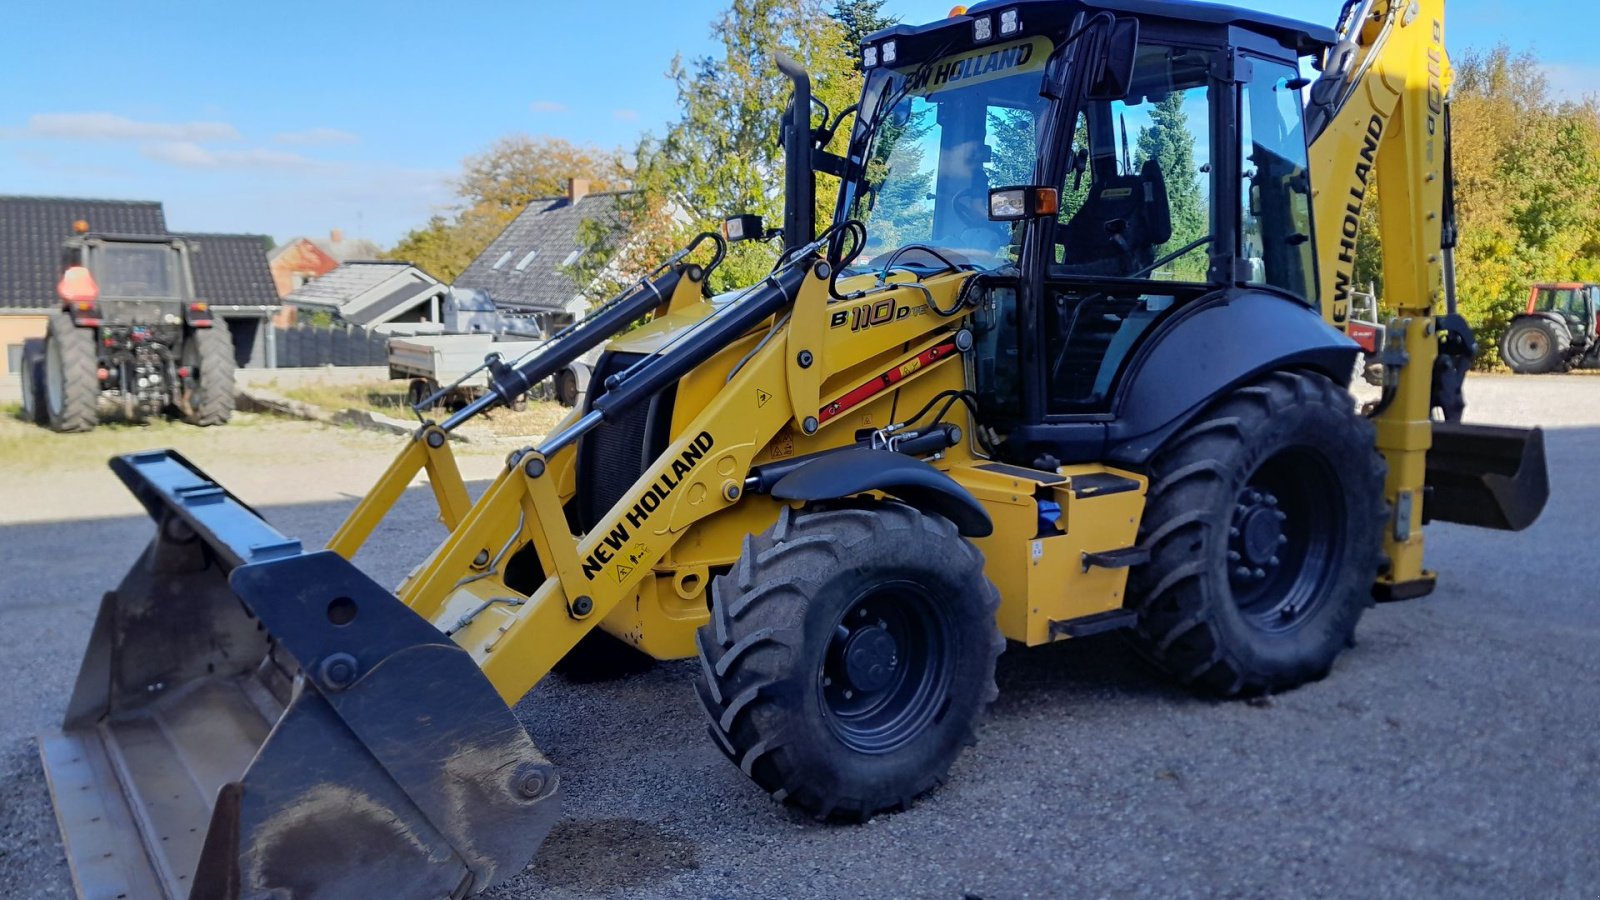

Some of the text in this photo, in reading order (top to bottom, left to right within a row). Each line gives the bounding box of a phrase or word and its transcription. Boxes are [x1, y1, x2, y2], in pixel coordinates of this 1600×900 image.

[934, 43, 1034, 85] HOLLAND
[1338, 113, 1383, 263] HOLLAND
[582, 431, 714, 580] NEW HOLLAND
